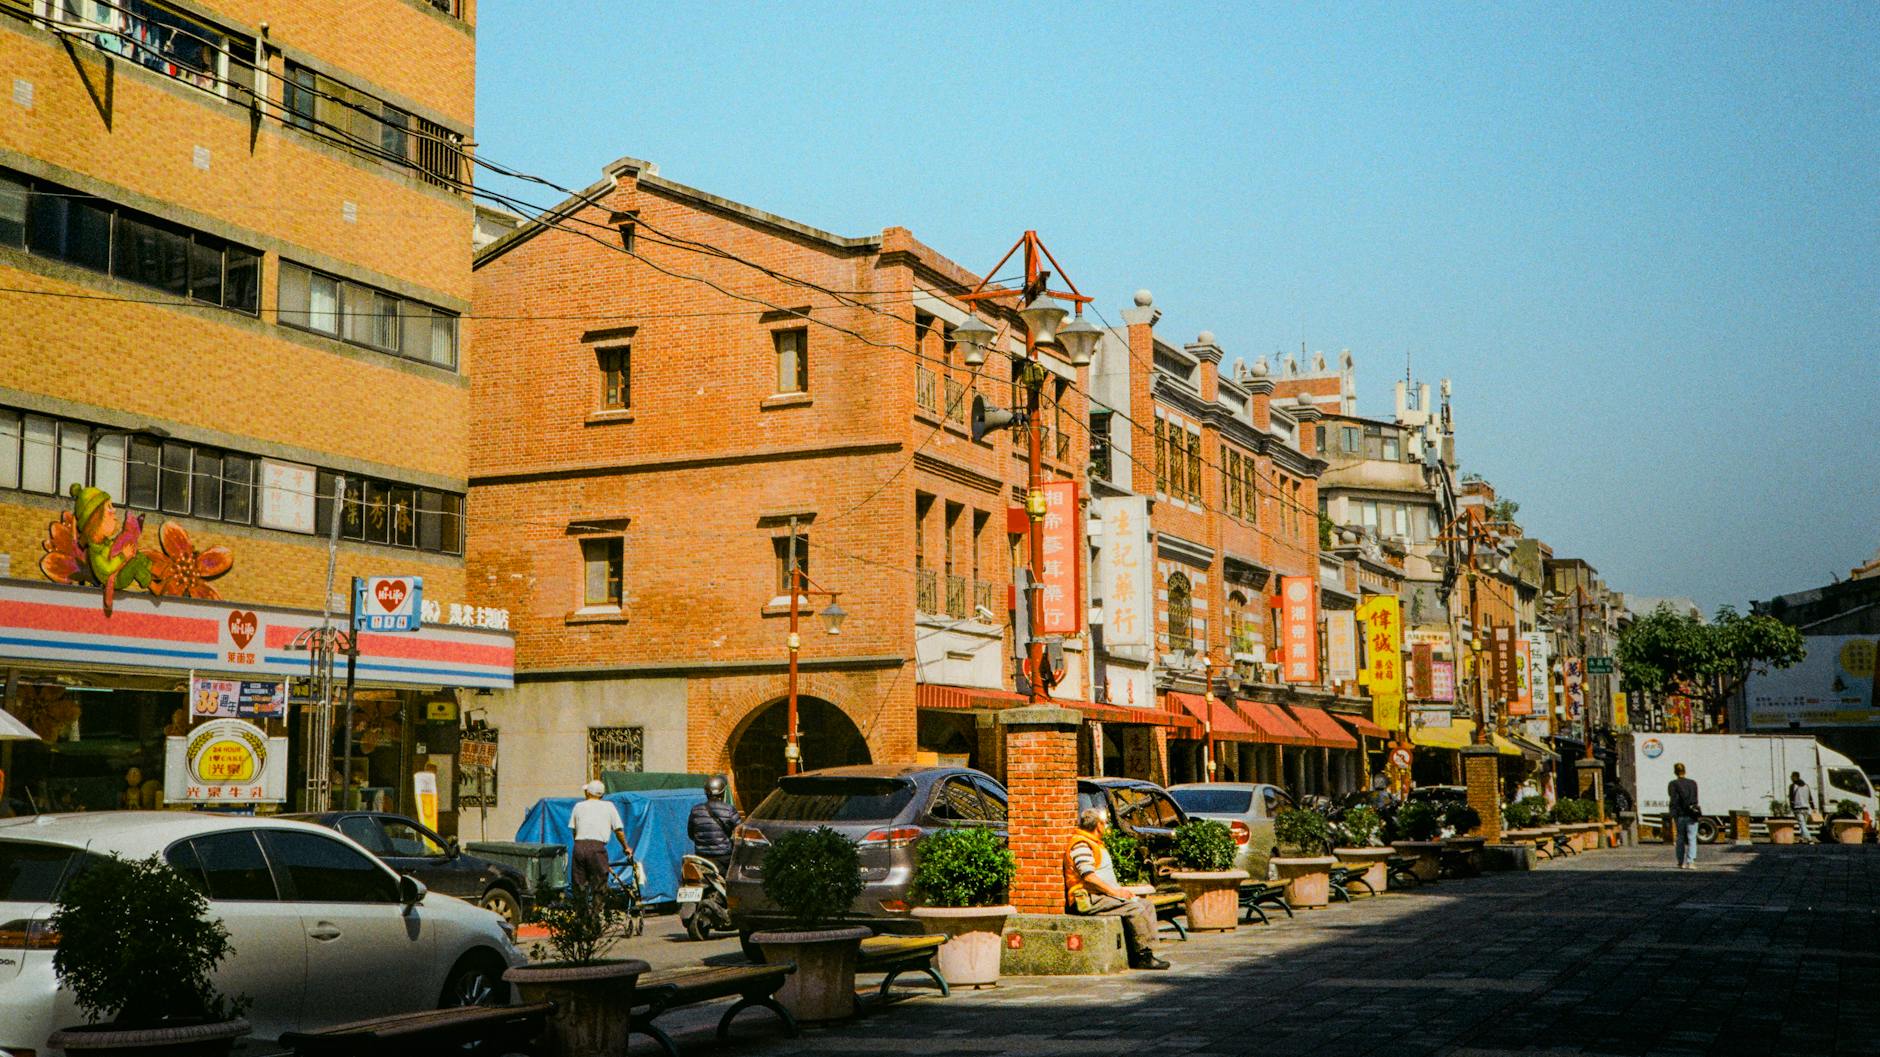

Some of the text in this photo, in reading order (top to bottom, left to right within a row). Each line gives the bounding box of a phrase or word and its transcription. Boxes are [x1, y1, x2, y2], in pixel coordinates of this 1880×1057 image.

[378, 586, 404, 604] Hi-Life
[231, 618, 255, 640] Hi-Life
[1371, 609, 1394, 654] 偉誠
[212, 764, 241, 775] 光泉
[186, 786, 262, 798] 光泉牛乳
